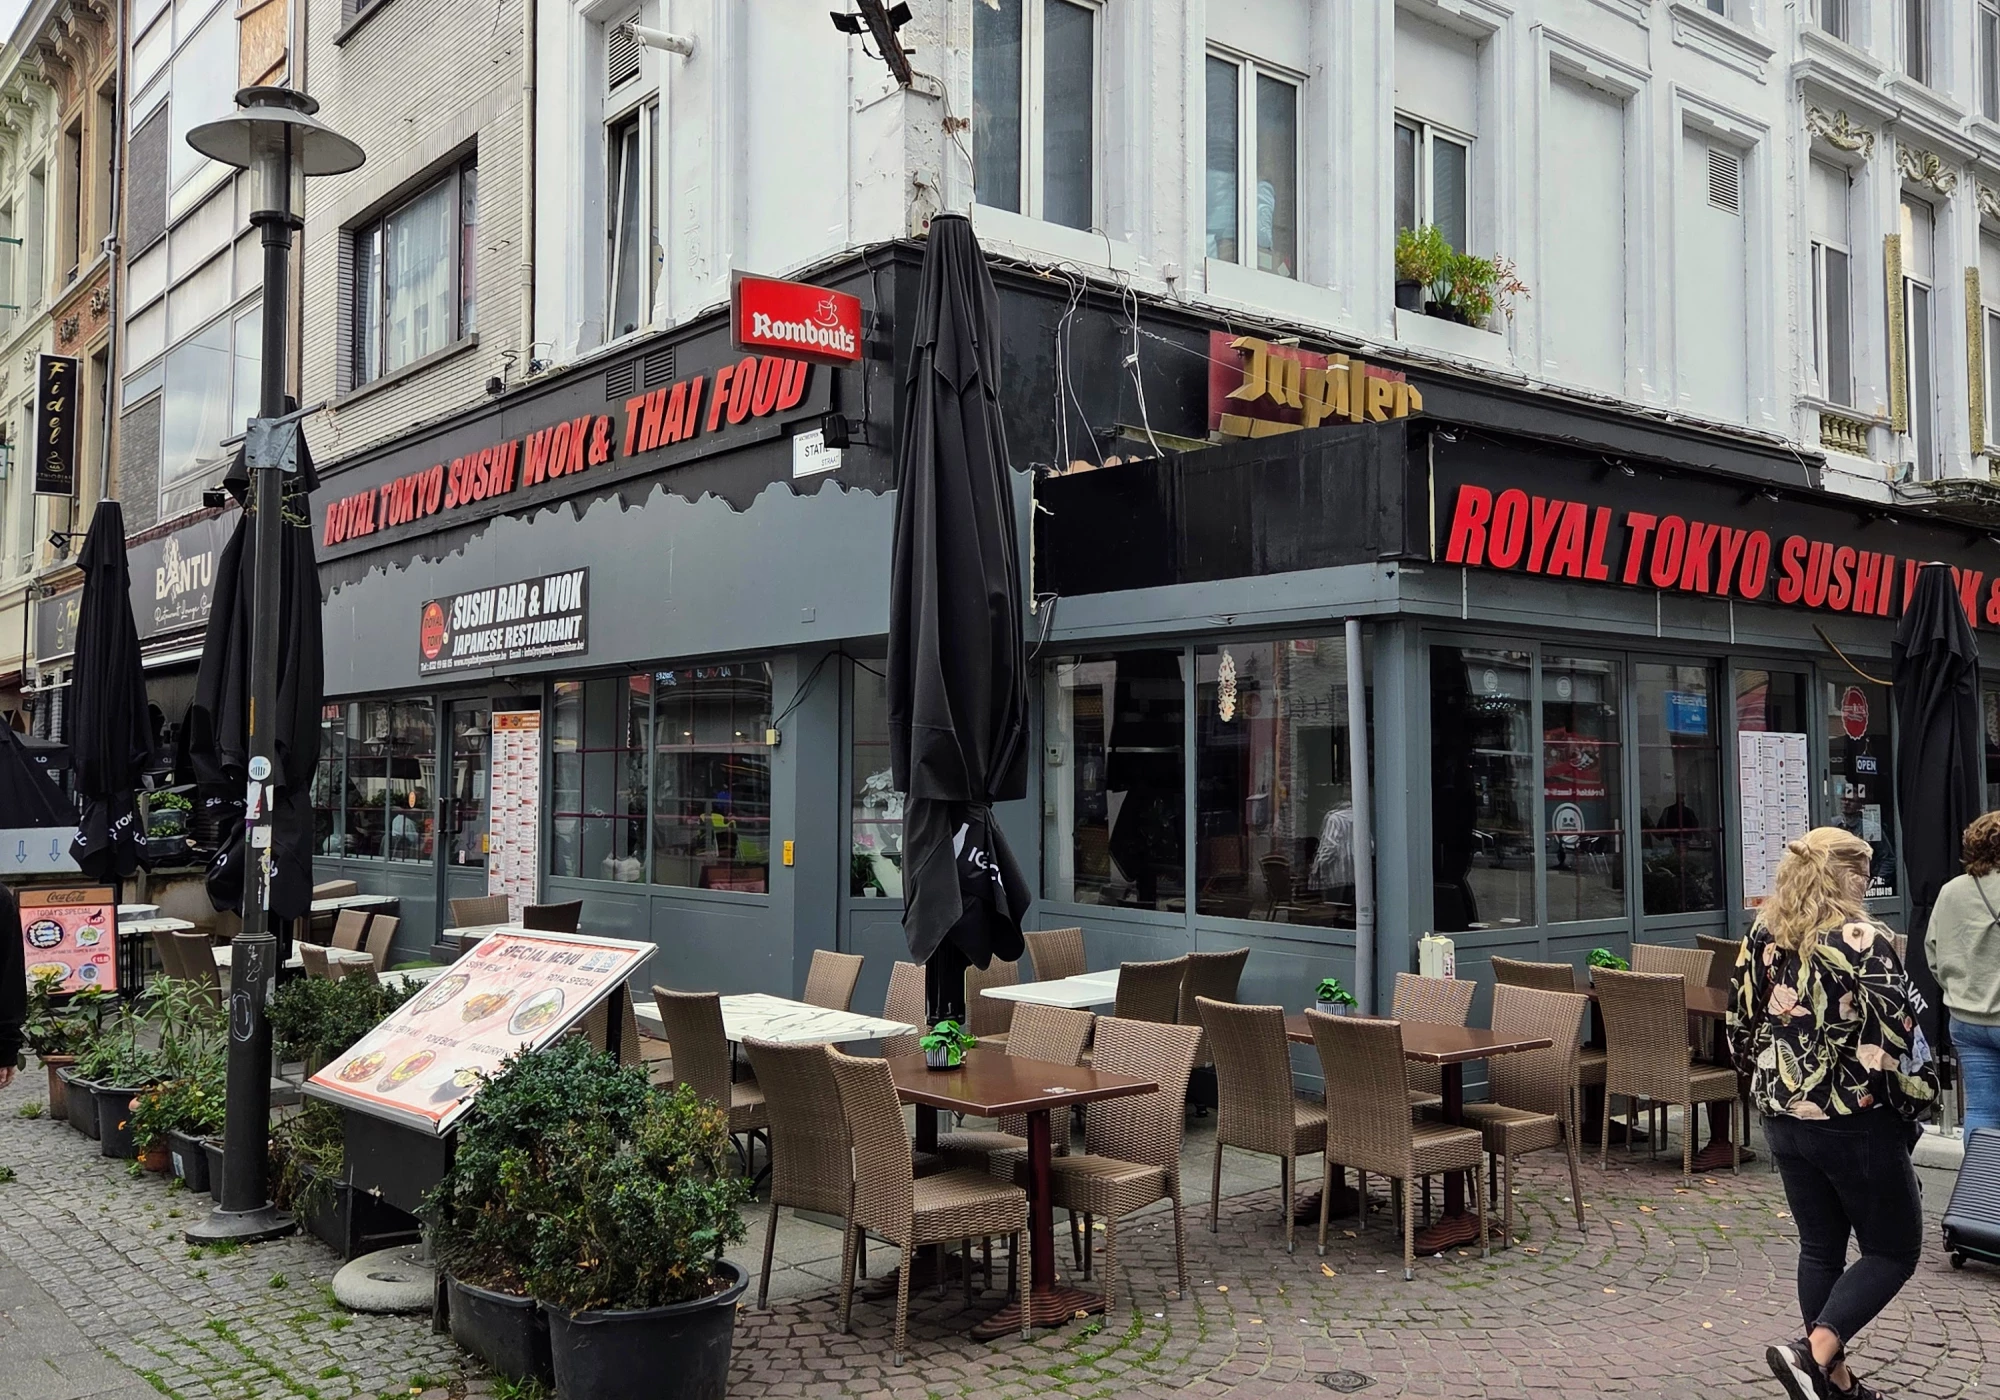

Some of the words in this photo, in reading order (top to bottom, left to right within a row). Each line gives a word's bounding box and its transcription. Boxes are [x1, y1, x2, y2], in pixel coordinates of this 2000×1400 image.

[752, 311, 855, 353] Rombouts
[46, 361, 68, 444] Fidel
[1225, 336, 1423, 428] Jupiler
[323, 489, 377, 546] ROYAL
[379, 464, 444, 530] TOKYO
[444, 439, 518, 509] SUSHI
[522, 414, 592, 487] WOK
[588, 415, 609, 465] &
[623, 375, 704, 457] THAI
[706, 355, 808, 432] FOOD
[1445, 484, 1612, 581] ROYAL
[1623, 511, 1771, 599] TOKYO
[1778, 534, 1896, 615] SUSHI
[452, 588, 496, 631] SUSHI
[496, 582, 527, 622] BAR
[528, 585, 541, 617] &
[543, 571, 584, 614] WOK
[452, 627, 504, 657] JAPANESE
[504, 615, 582, 649] RESTAURANT
[1857, 758, 1876, 771] OPEN
[64, 908, 92, 916] SPECIAL
[498, 945, 548, 962] SPECIAL
[543, 951, 585, 966] MENU
[545, 973, 568, 981] ROYAL
[566, 976, 598, 987] SPECIAL
[1908, 981, 1928, 1014] VAT
[466, 1042, 482, 1052] THAI
[481, 1045, 505, 1056] CURRY
